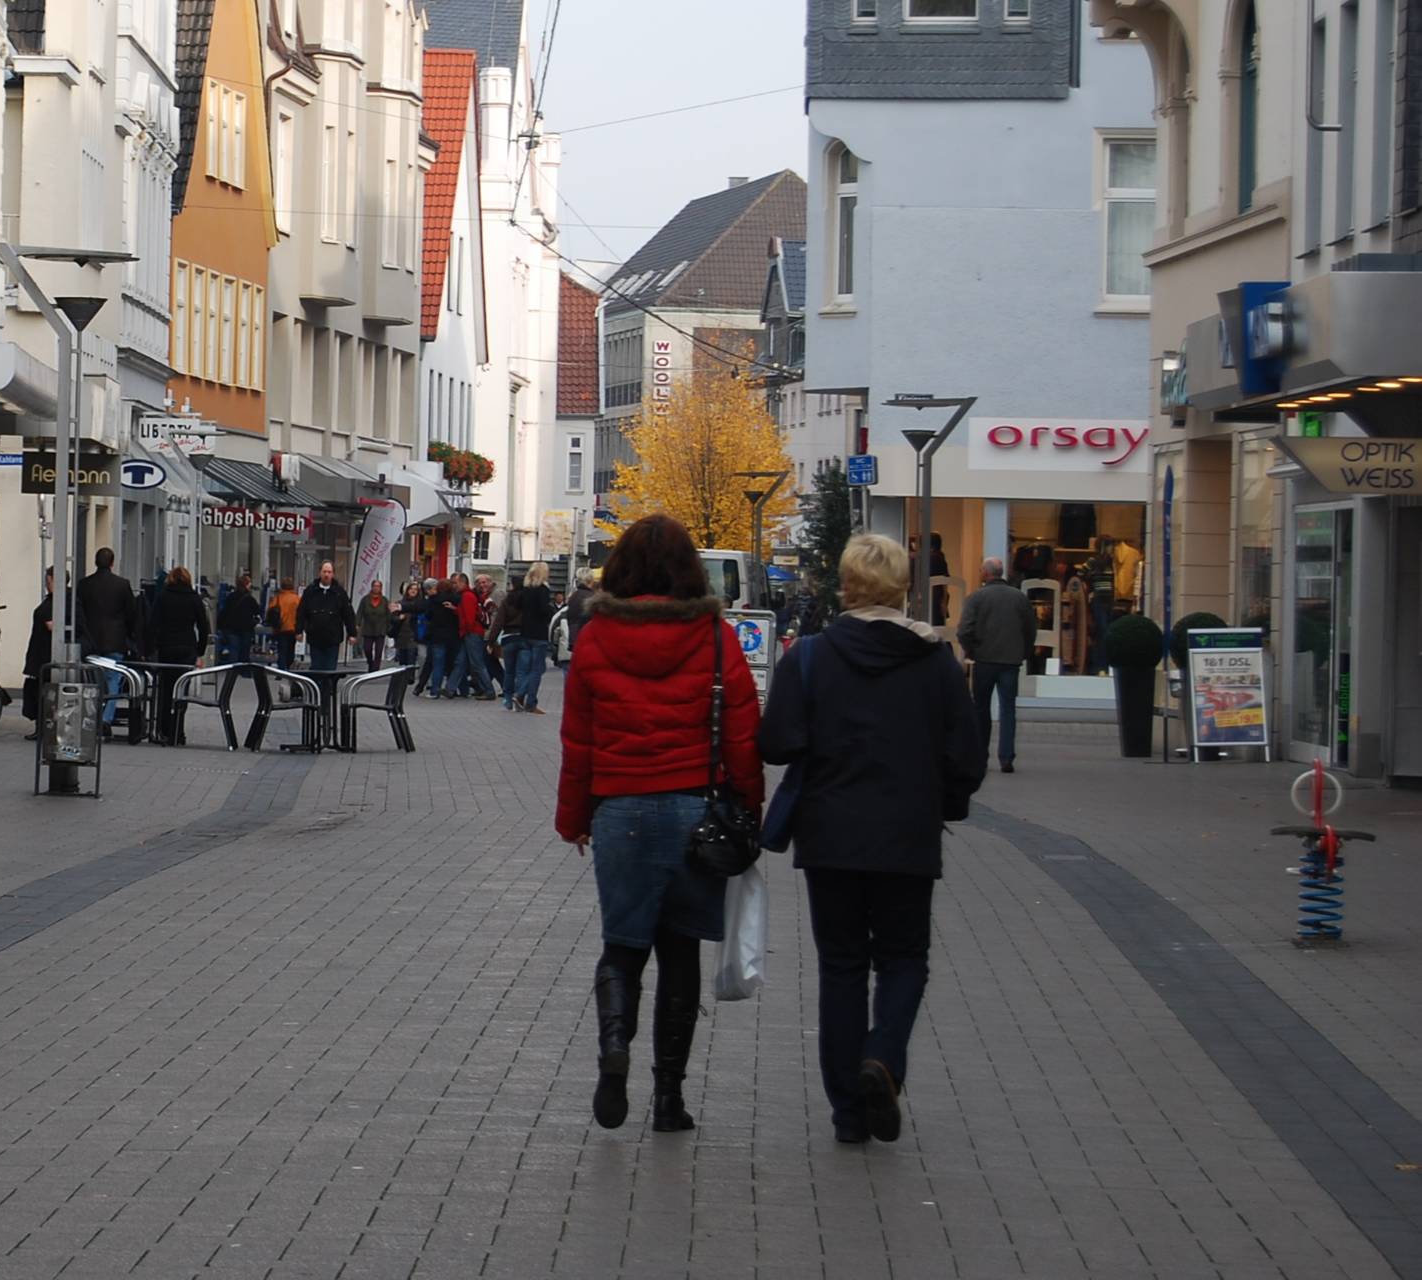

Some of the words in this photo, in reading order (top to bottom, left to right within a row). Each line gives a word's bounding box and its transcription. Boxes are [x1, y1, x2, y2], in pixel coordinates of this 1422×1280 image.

[987, 425, 1150, 465] orsay
[1340, 441, 1415, 463] OPTIK
[1340, 467, 1414, 489] WEISS
[202, 507, 255, 530] Ghosh
[255, 511, 306, 534] Ghosh
[360, 529, 386, 566] Hier!
[1203, 657, 1224, 667] 1&1
[1228, 657, 1251, 667] DSL
